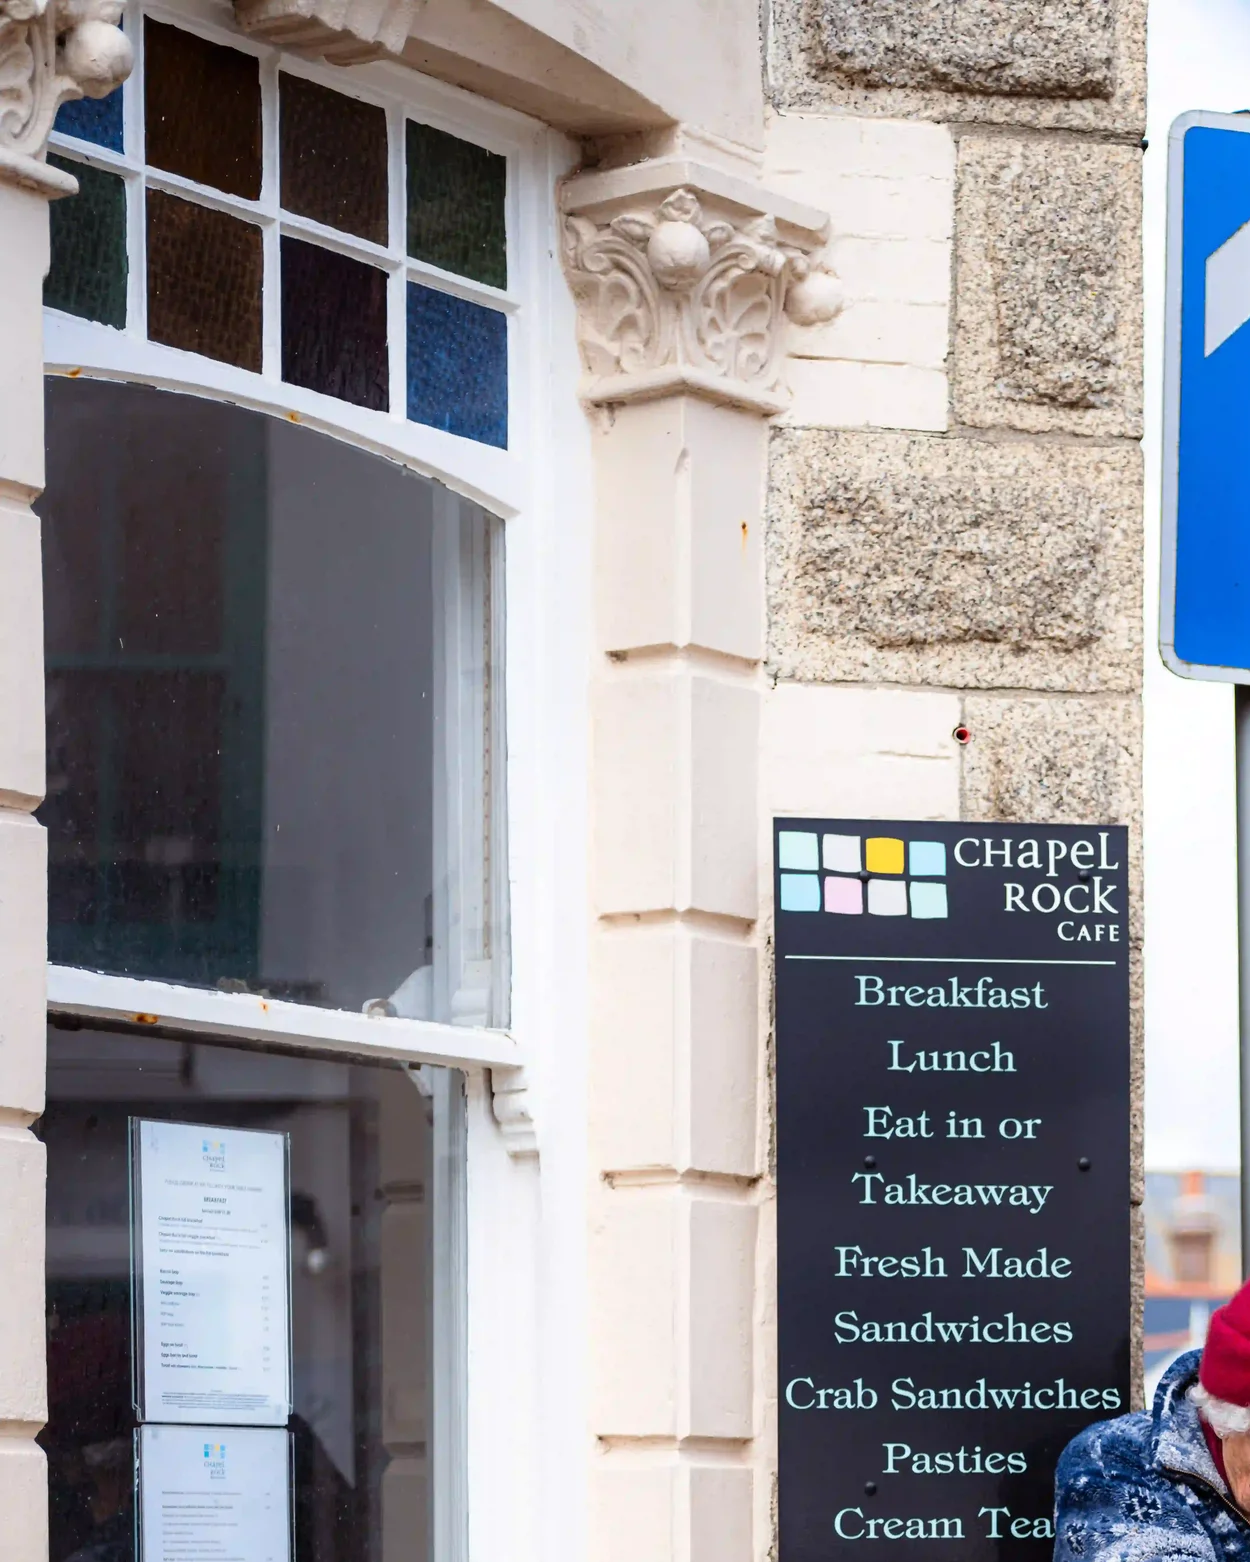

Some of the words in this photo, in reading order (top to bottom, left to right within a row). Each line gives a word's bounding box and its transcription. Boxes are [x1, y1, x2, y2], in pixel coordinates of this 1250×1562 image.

[1056, 920, 1121, 943] CAFE
[853, 975, 1049, 1009] Breakfast
[886, 1040, 1018, 1074] Lunch
[862, 1105, 935, 1140] Eat
[945, 1110, 986, 1139] in
[998, 1116, 1042, 1140] or
[851, 1172, 1054, 1215] Takeaway
[834, 1244, 949, 1278] Fresh
[961, 1247, 1073, 1279] Made
[834, 1310, 1073, 1344] Sandwiches
[785, 1376, 878, 1410] Crab
[891, 1376, 1121, 1411] Sandwiches
[881, 1443, 1028, 1475] Pasties
[834, 1506, 966, 1540] Cream
